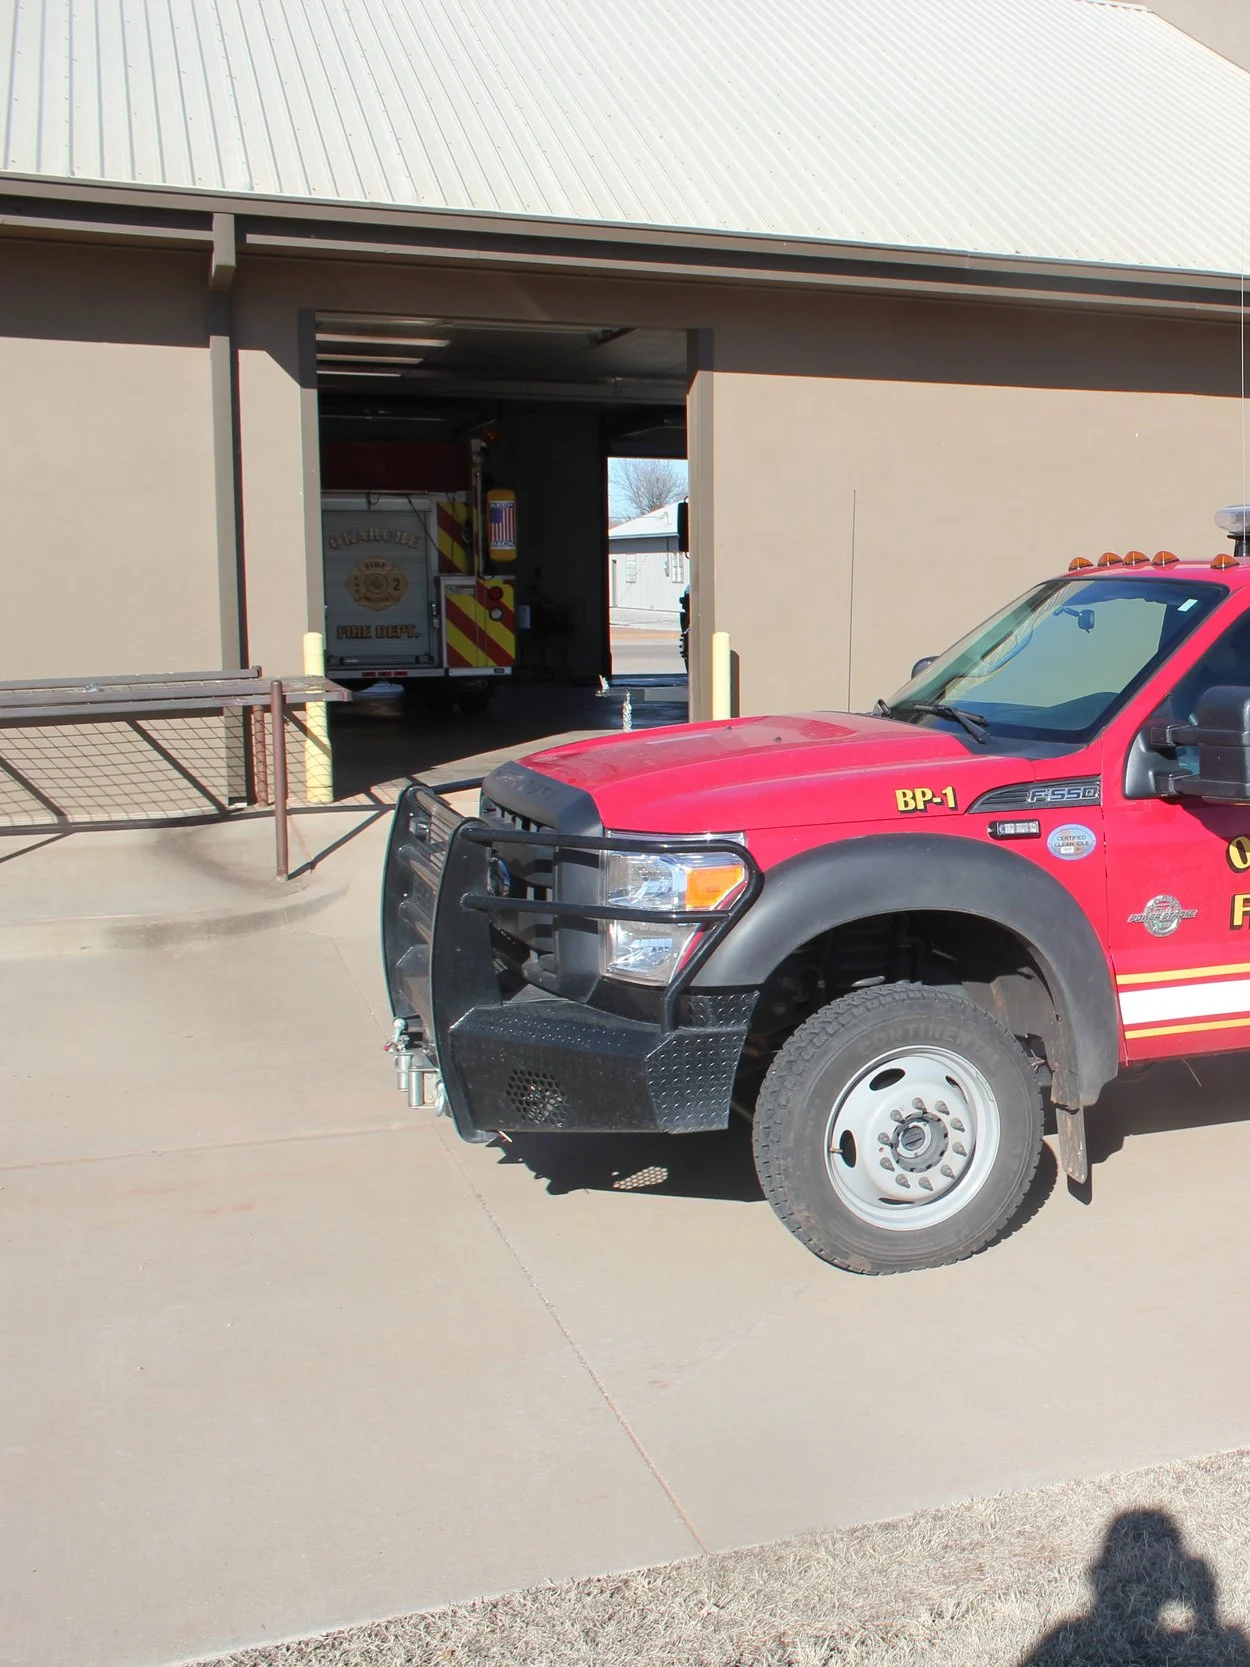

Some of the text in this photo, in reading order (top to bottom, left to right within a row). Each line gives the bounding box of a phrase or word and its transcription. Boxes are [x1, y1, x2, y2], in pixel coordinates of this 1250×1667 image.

[328, 528, 421, 550] OKARCHE
[363, 561, 386, 571] FIRE
[393, 577, 401, 591] 2
[335, 624, 421, 639] FIRE DEPT.
[894, 785, 957, 813] BP-1
[1129, 909, 1198, 922] POWER STROKE
